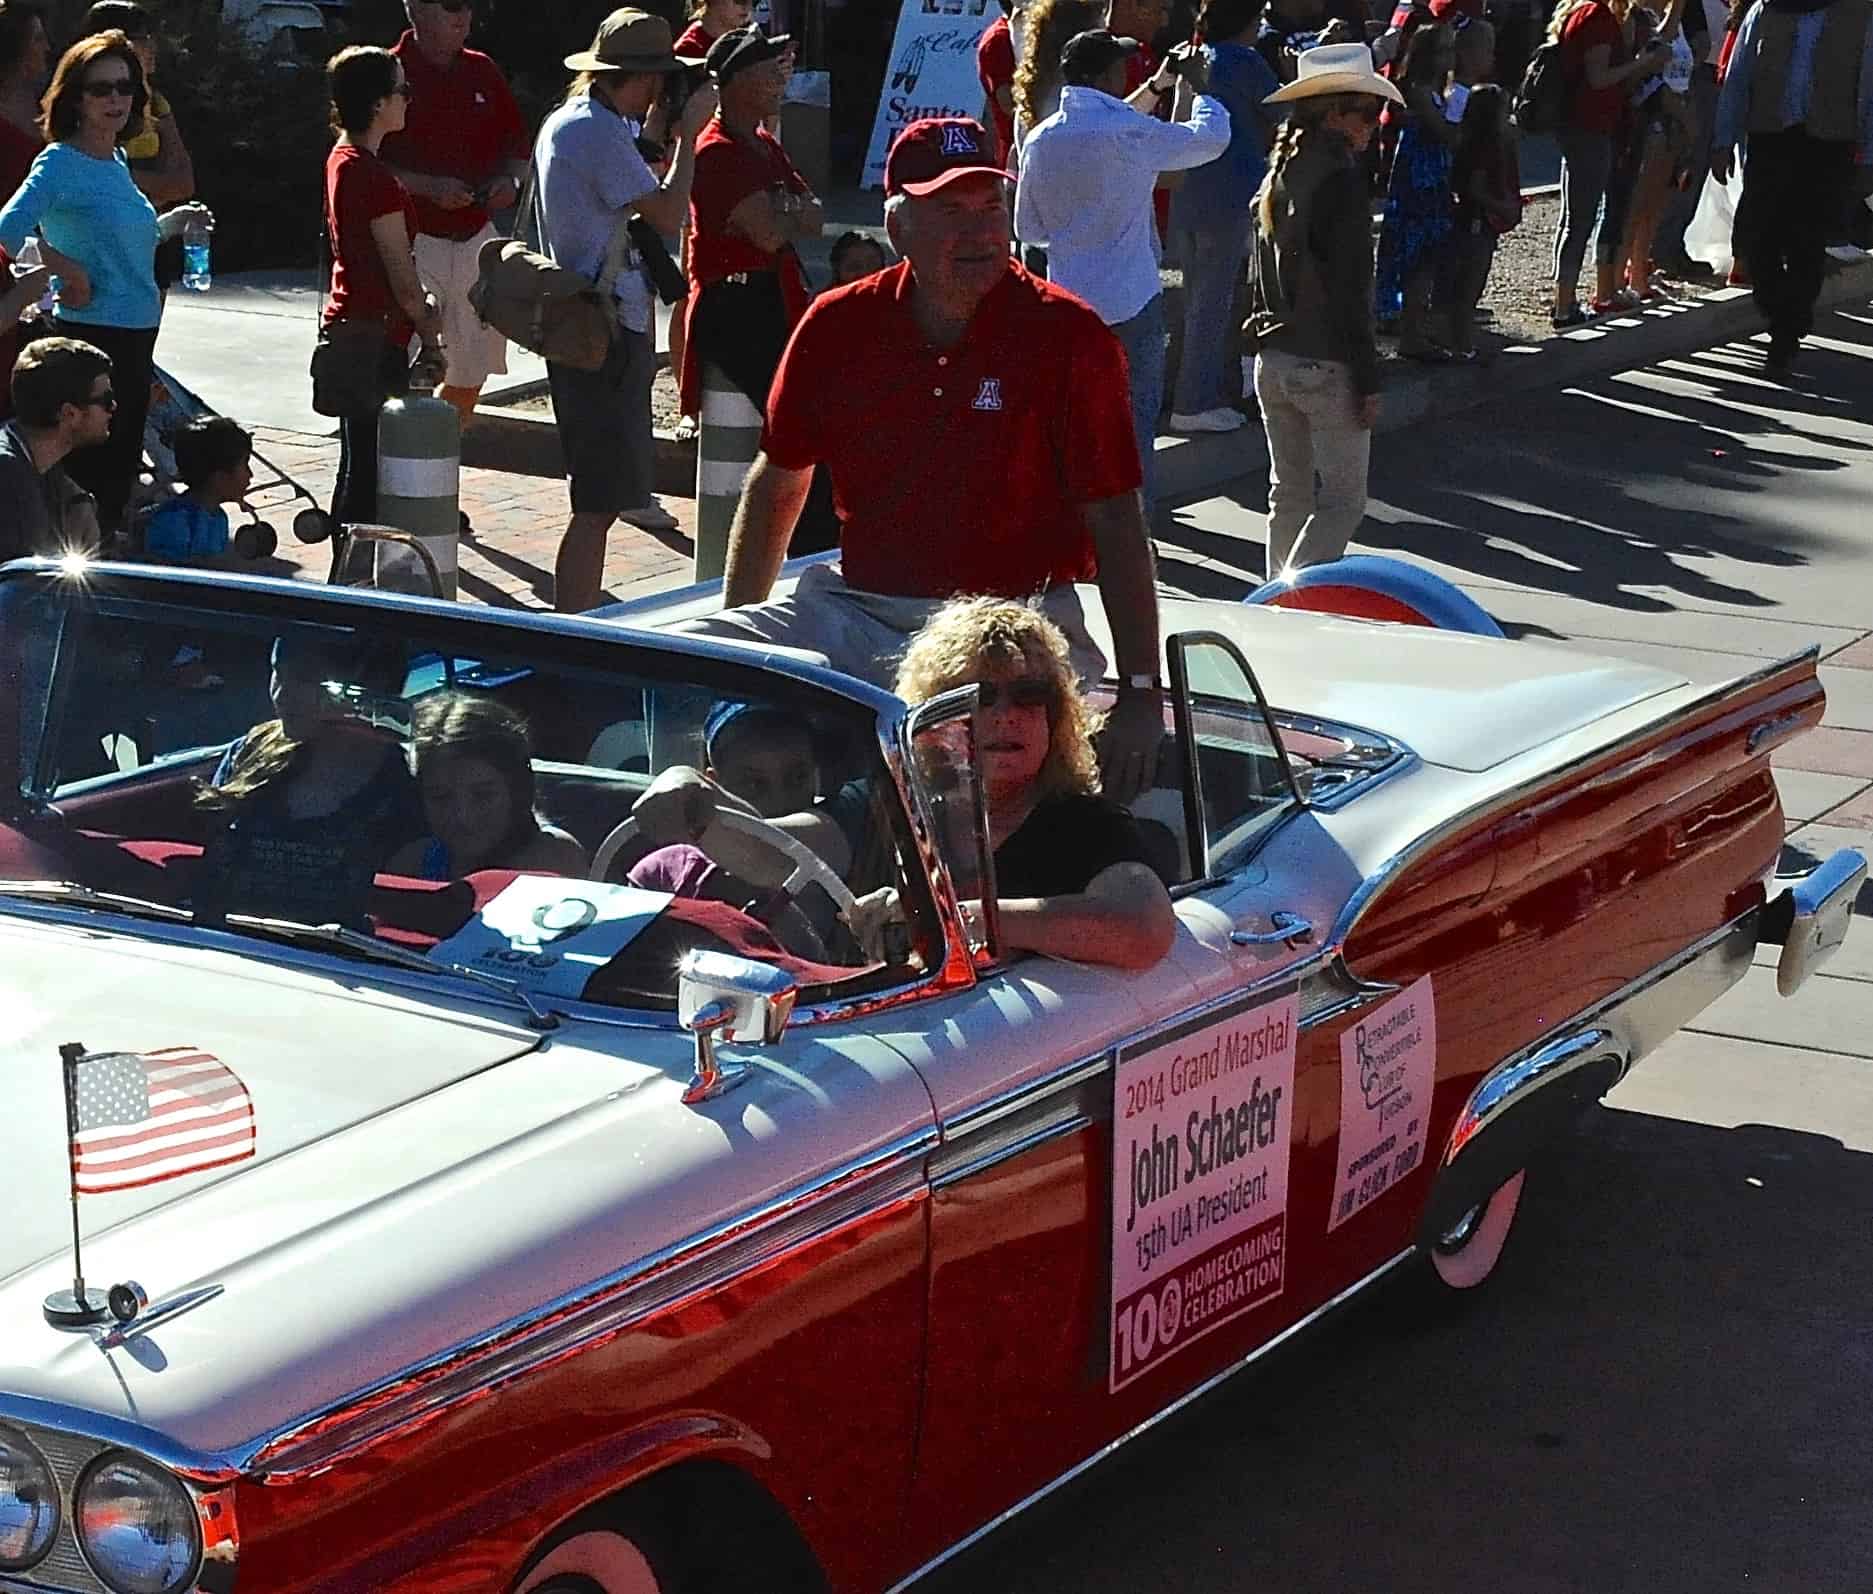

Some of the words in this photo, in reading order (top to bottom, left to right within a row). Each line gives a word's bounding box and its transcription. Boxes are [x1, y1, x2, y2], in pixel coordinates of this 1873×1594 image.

[941, 124, 979, 155] A
[971, 378, 1002, 410] A
[1126, 1071, 1165, 1119] 2014
[1170, 1036, 1220, 1097] Grand
[1224, 1008, 1291, 1074] Marshal
[1126, 1123, 1179, 1233] John
[1184, 1075, 1283, 1185] Schaefer
[1136, 1215, 1167, 1273] 15th
[1171, 1203, 1193, 1247] UA
[1197, 1164, 1269, 1233] President
[1183, 1255, 1281, 1328] CELEBRATION
[1184, 1226, 1282, 1300] HOMECOMING
[1117, 1277, 1182, 1372] 100
